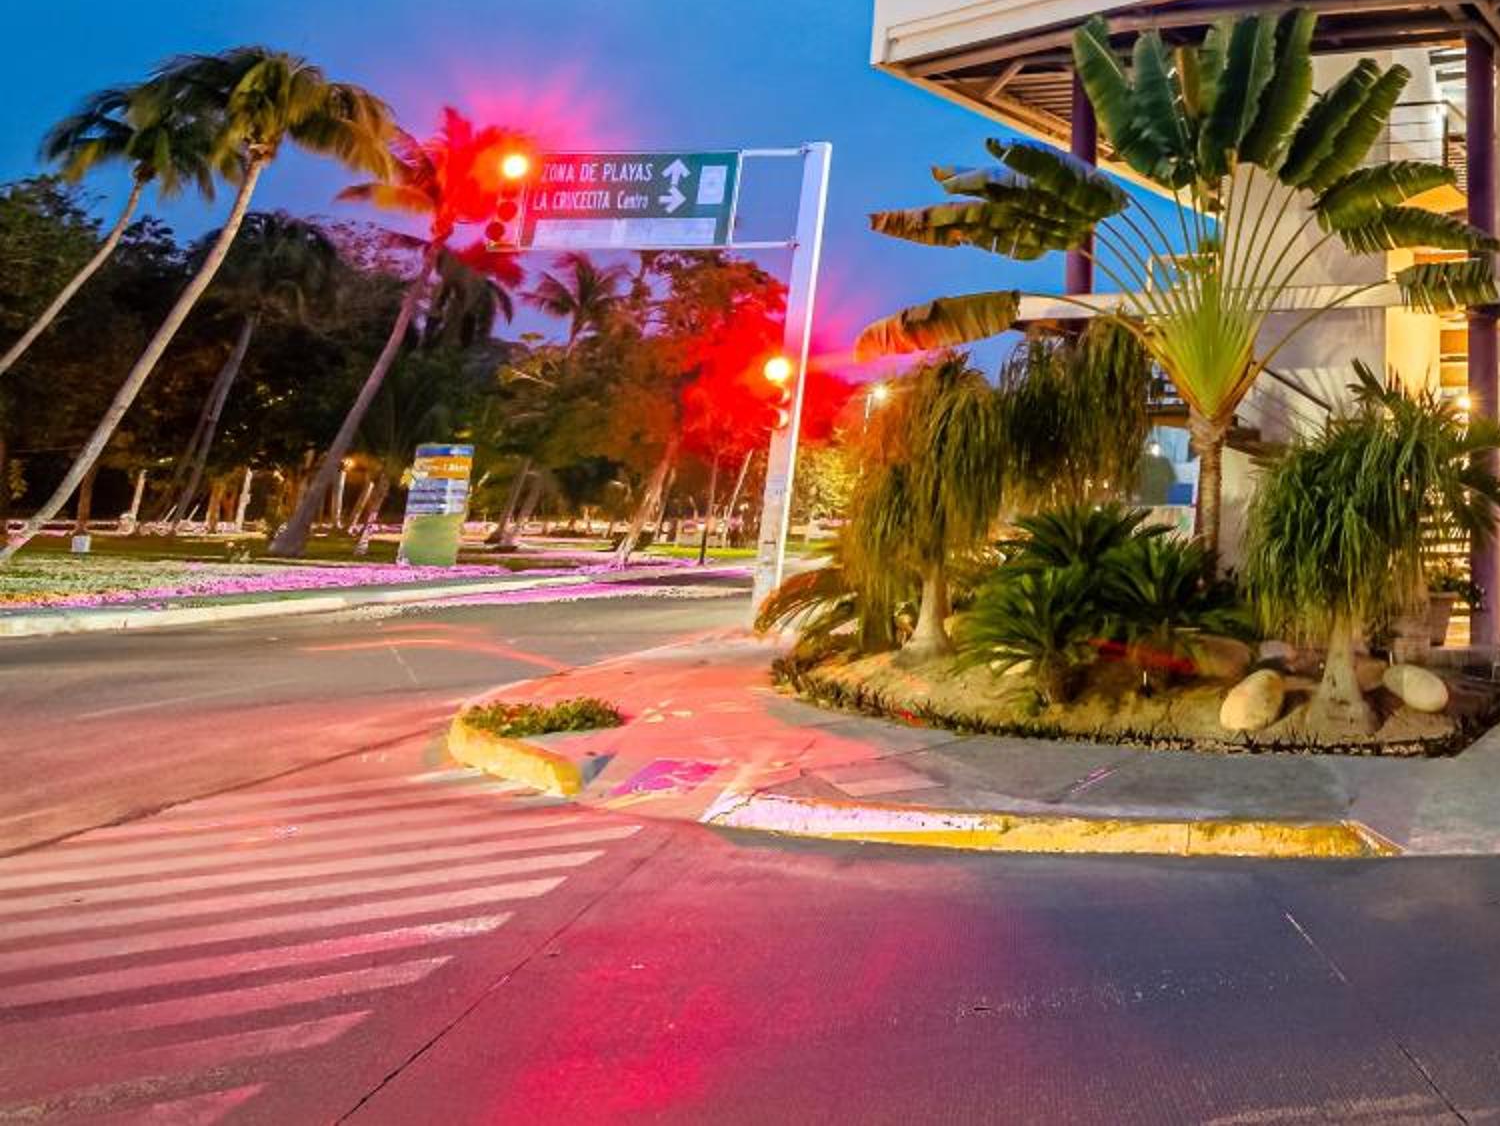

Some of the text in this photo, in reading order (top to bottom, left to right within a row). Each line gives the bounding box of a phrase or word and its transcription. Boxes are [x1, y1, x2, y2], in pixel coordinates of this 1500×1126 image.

[541, 163, 654, 183] ZONA DE PLAYAS
[532, 191, 547, 211] LA
[553, 190, 611, 210] CRUCECITA
